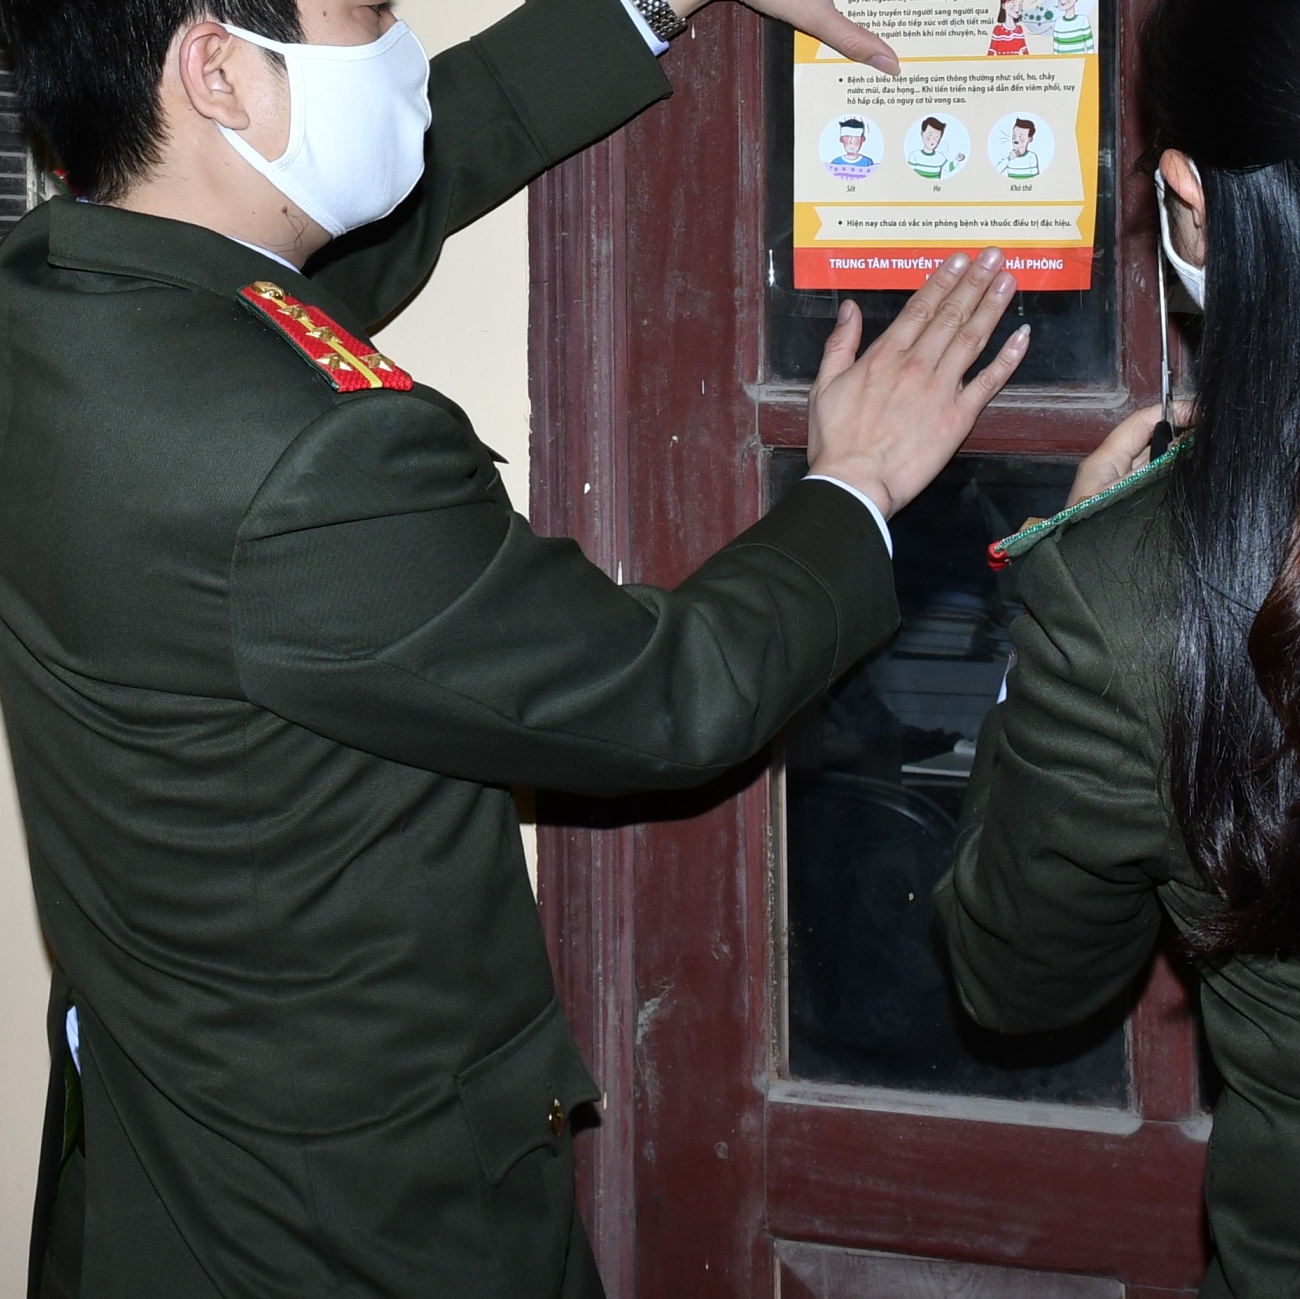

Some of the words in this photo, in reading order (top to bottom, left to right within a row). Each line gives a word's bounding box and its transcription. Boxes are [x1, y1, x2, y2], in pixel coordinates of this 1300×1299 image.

[829, 260, 865, 270] TRUNG
[867, 257, 890, 269] TÂM
[891, 256, 932, 269] TRUYỀN
[1005, 257, 1025, 270] HẢI
[1027, 257, 1063, 270] PHÒNG
